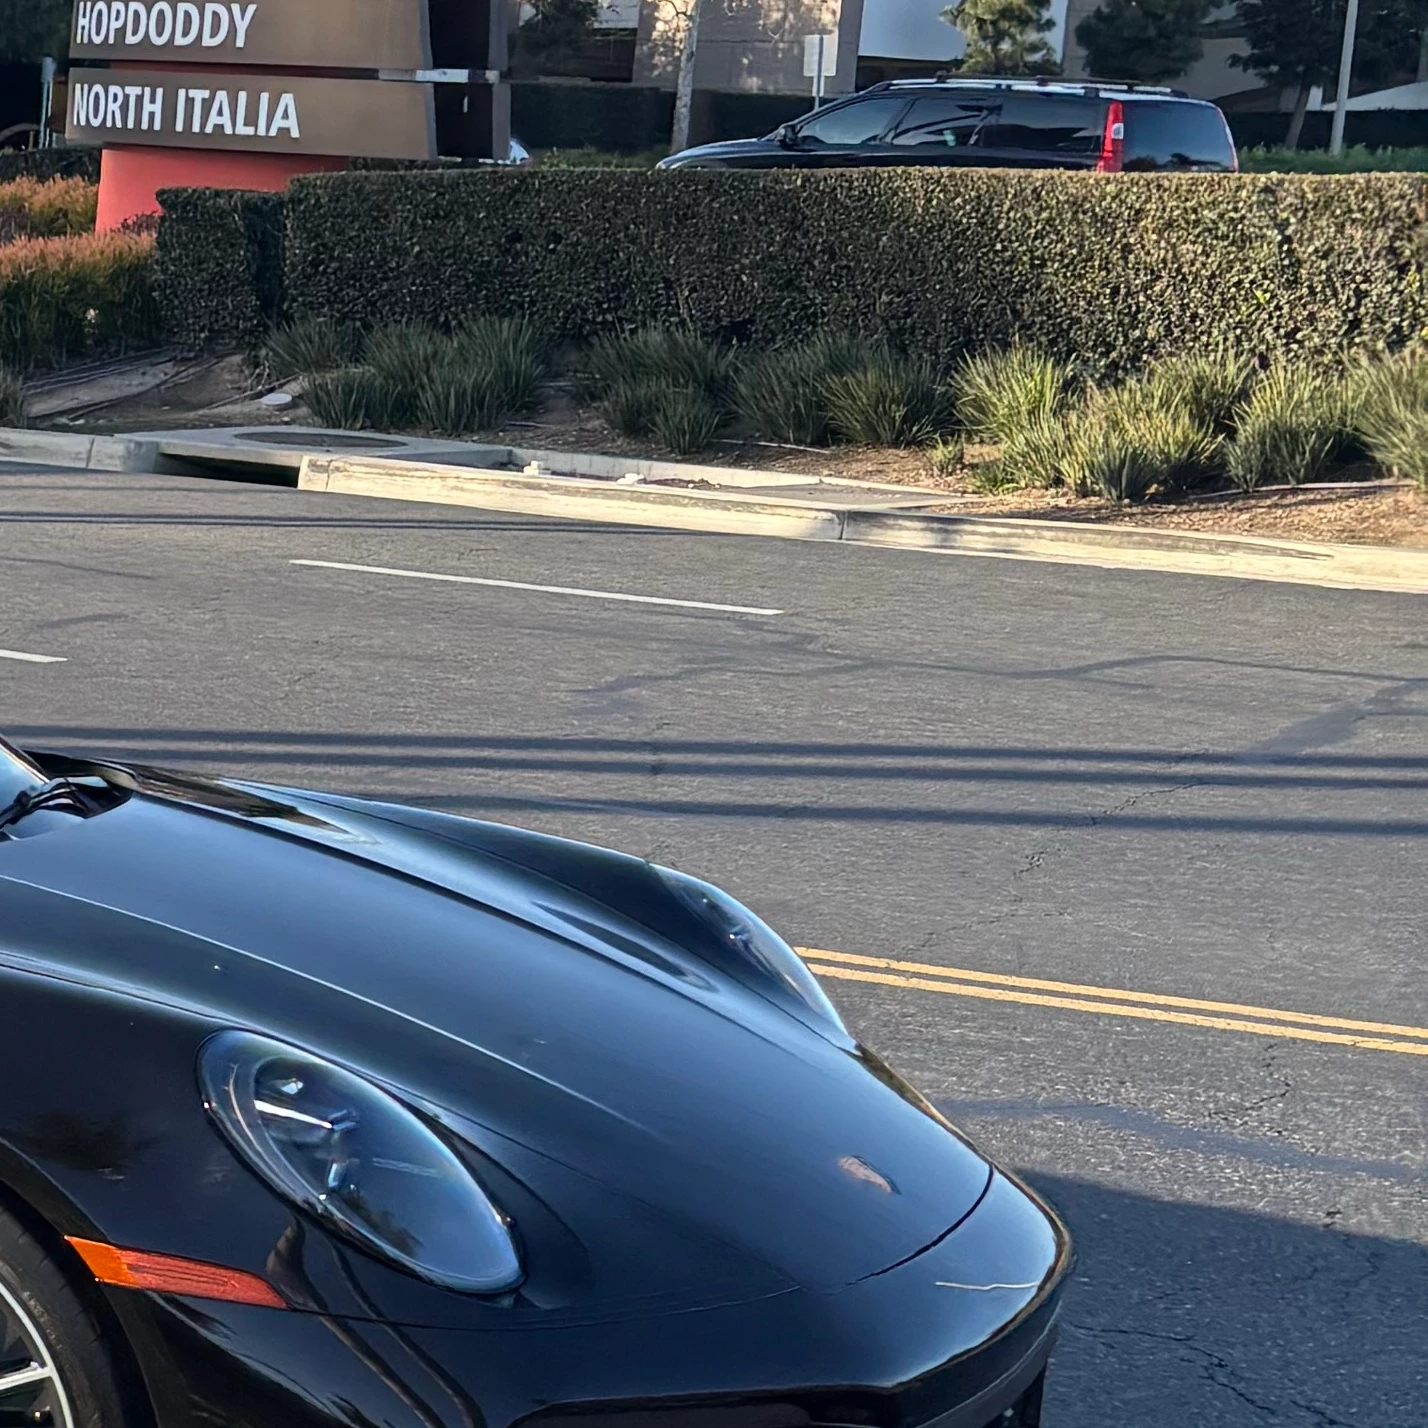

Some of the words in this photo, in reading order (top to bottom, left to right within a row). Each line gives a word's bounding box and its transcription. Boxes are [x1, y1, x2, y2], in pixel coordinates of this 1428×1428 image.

[75, 0, 258, 49] HOPDODDY
[72, 82, 164, 132] NORTH
[174, 88, 301, 139] ITALIA
